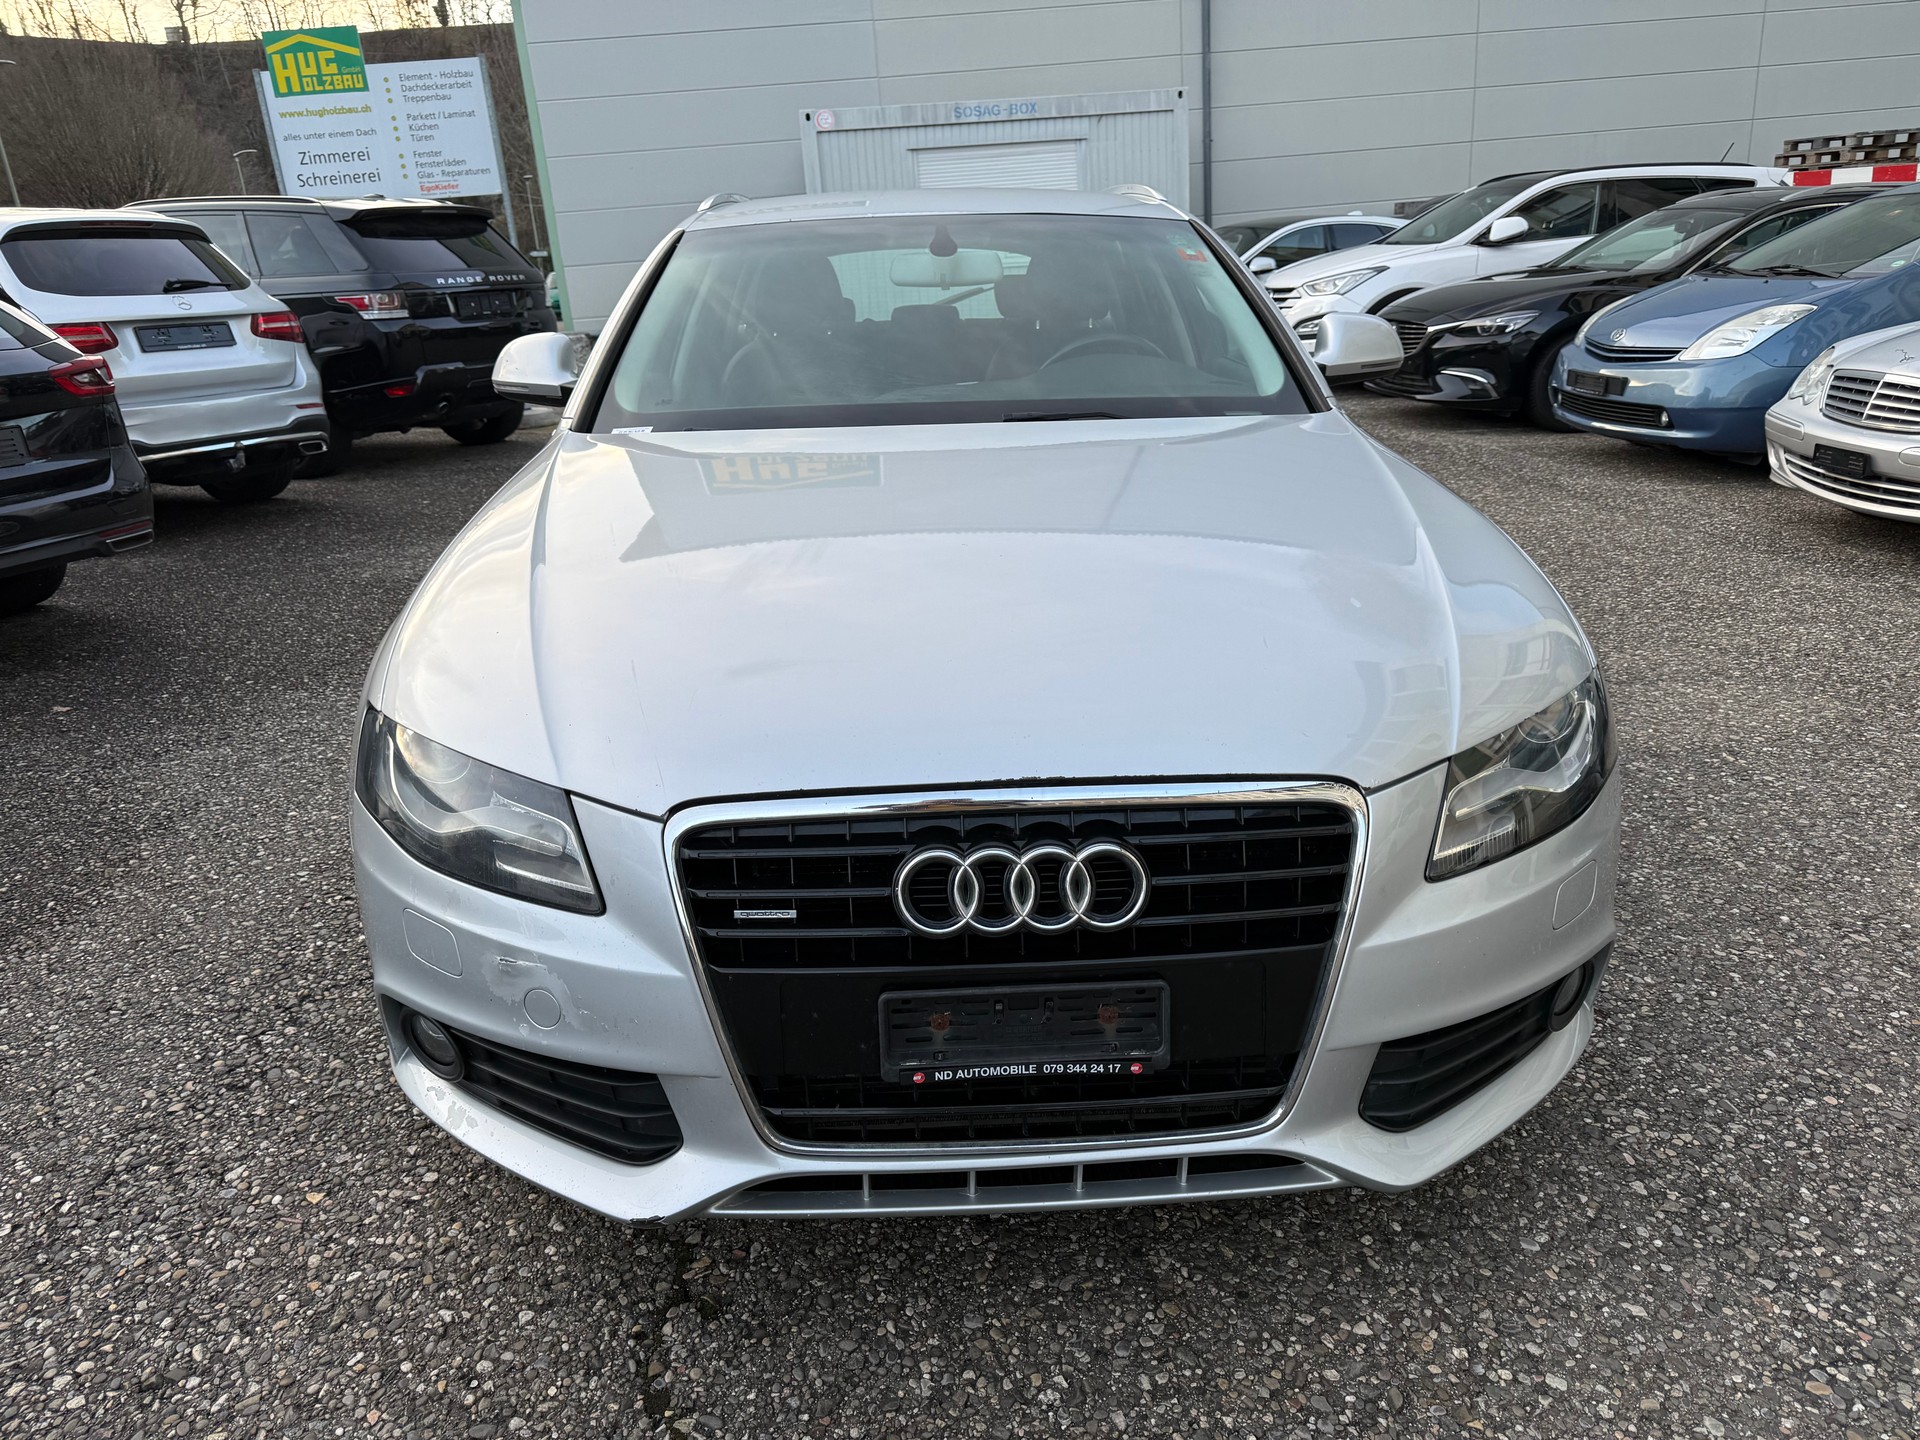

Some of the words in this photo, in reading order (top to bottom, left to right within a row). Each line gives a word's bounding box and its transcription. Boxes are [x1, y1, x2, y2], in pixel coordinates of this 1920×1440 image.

[398, 72, 433, 82] Element
[439, 70, 474, 79] Holzbau
[400, 80, 472, 92] Dachdeckerarbeit
[402, 93, 451, 104] Treppenbau
[278, 104, 372, 119] www.hugholzbau.ch
[406, 112, 436, 121] Parkett
[442, 109, 476, 119] Laminat
[954, 102, 1038, 119] SOSAG-BOX
[408, 122, 439, 132] Küchen
[283, 133, 301, 142] alles
[303, 131, 326, 141] unter
[328, 129, 354, 138] einem
[356, 128, 377, 138] Dach
[410, 133, 434, 142] Türen
[298, 146, 371, 166] Zimmerei
[413, 150, 442, 159] Fenster
[415, 159, 467, 169] Fensterläden
[297, 168, 381, 188] Schreinerei
[417, 170, 435, 179] Glas
[441, 167, 491, 178] Reparaturen
[436, 276, 483, 285] RANGE
[488, 274, 526, 282] ROVER
[935, 1070, 953, 1081] ND
[956, 1064, 1037, 1078] AUTOMOBILE
[1043, 1063, 1064, 1074] 079
[1067, 1063, 1088, 1073] 344
[1090, 1063, 1104, 1073] 24
[1107, 1063, 1121, 1073] 17
